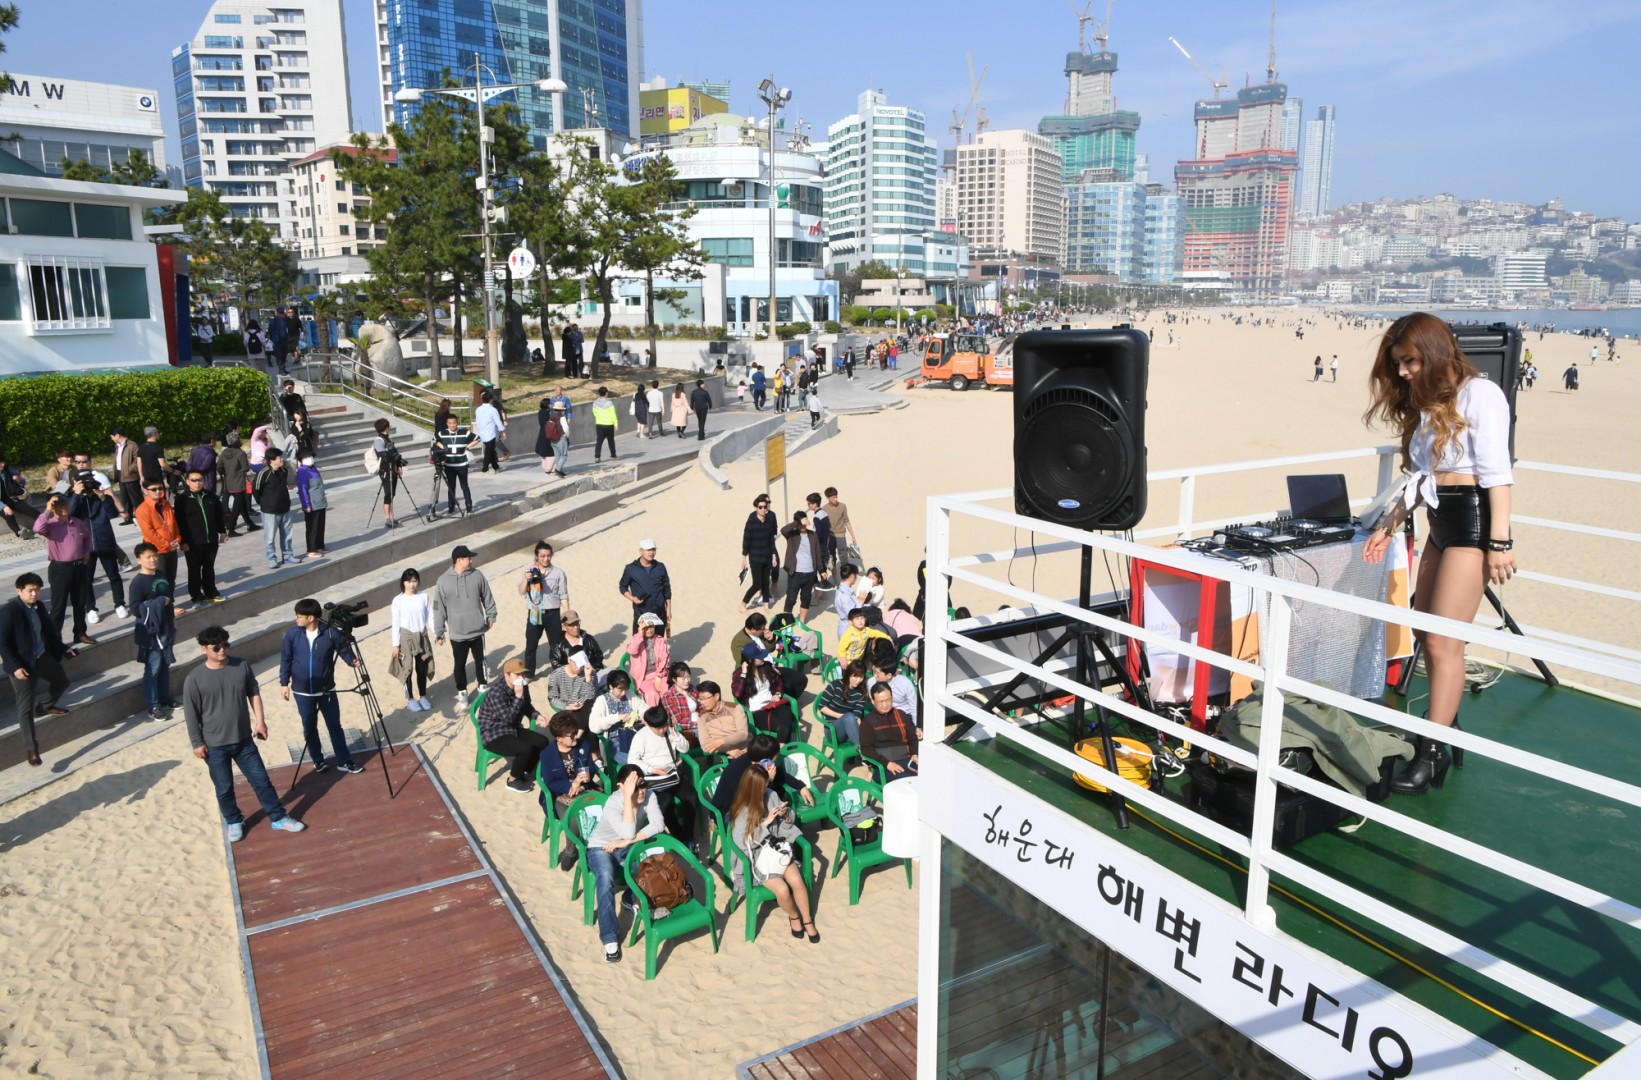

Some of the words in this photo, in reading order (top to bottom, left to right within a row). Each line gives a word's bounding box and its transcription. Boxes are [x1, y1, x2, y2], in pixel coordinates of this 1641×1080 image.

[9, 80, 64, 100] MW
[876, 108, 905, 116] NOVOTEL
[983, 805, 1075, 870] 해운대
[1097, 863, 1202, 984] 해변
[1232, 940, 1414, 1080] 라디오
